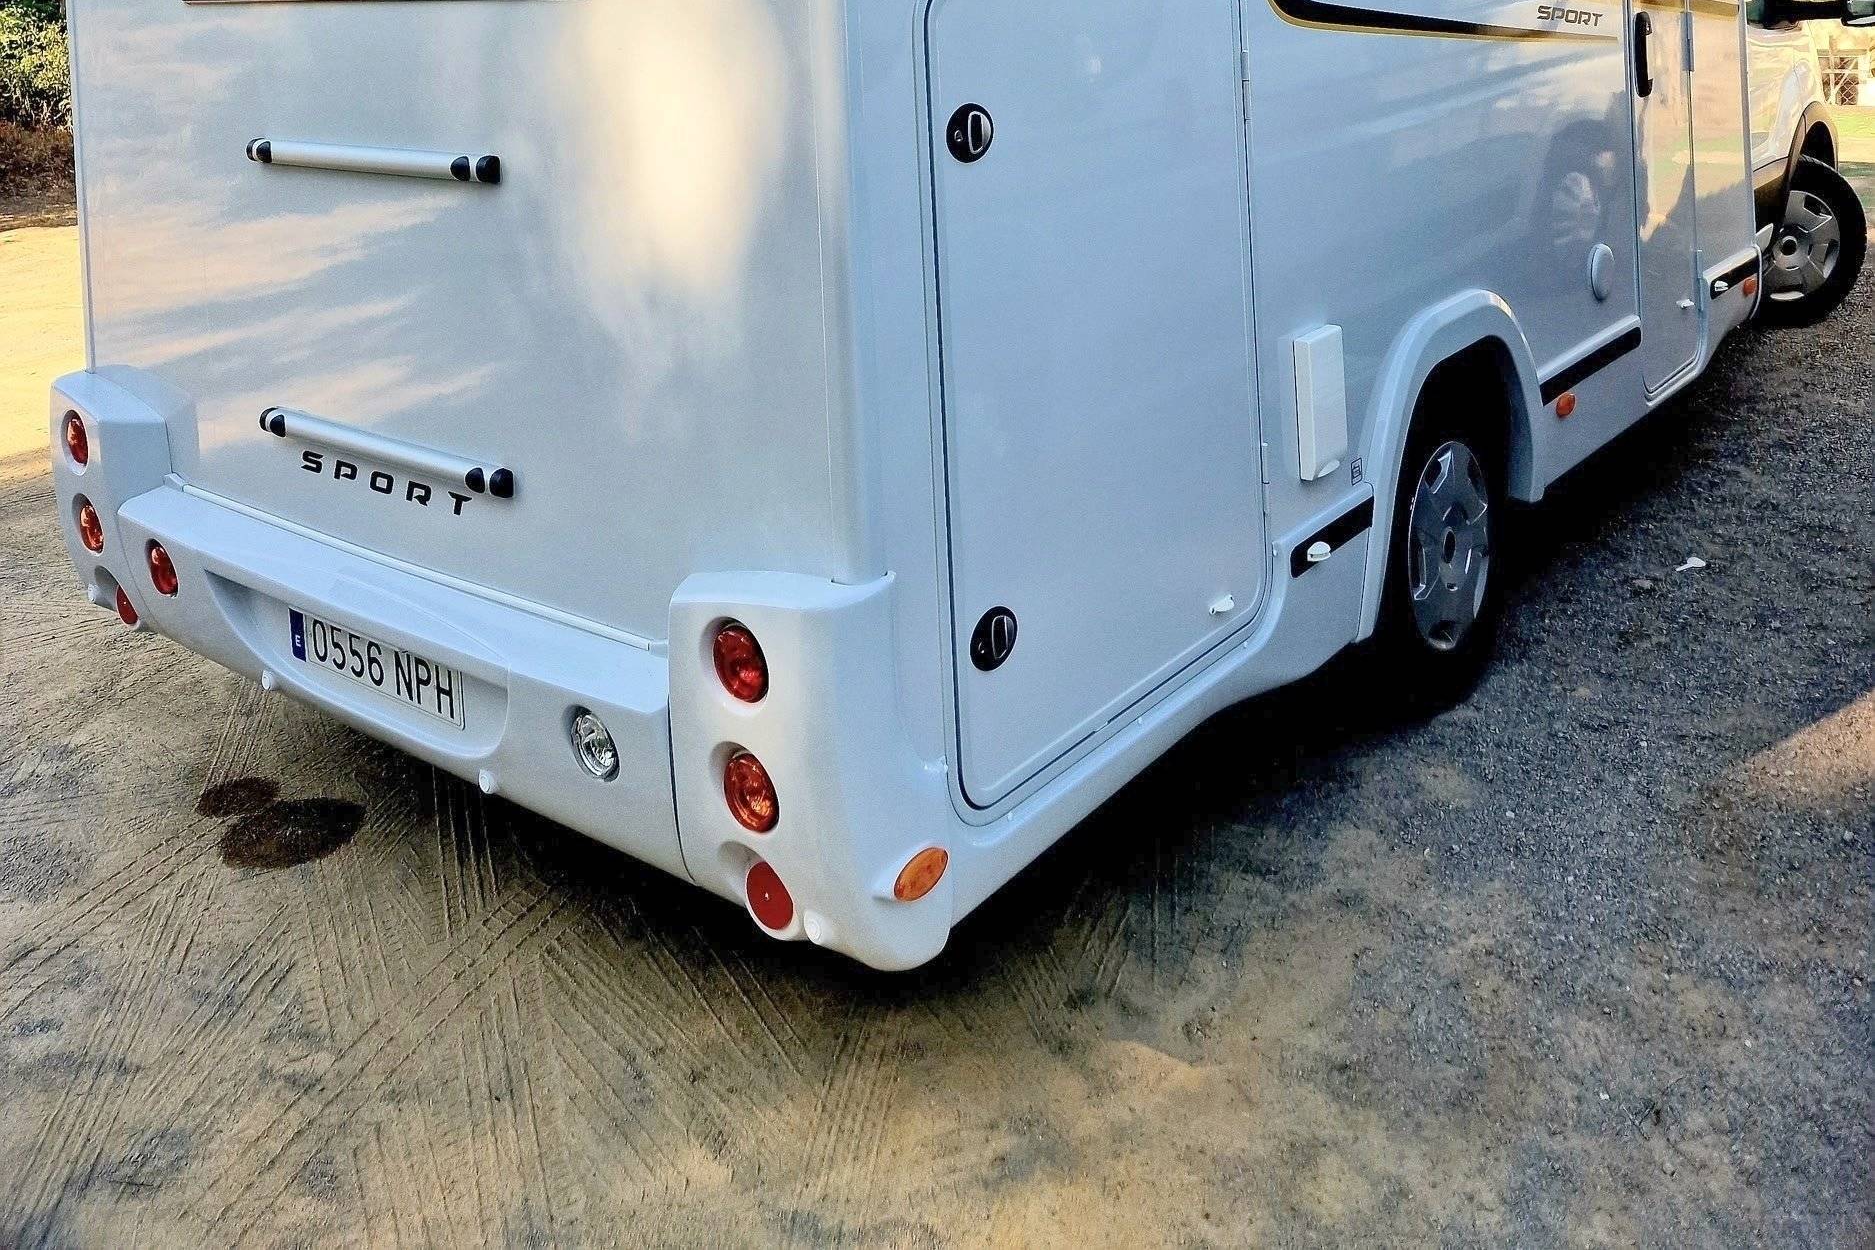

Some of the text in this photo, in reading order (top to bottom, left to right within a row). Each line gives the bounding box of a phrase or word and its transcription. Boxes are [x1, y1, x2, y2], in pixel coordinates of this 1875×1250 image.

[1536, 5, 1604, 27] SPORT
[300, 449, 474, 517] SPORT
[294, 634, 302, 648] E
[312, 618, 455, 720] 0556 NPH
